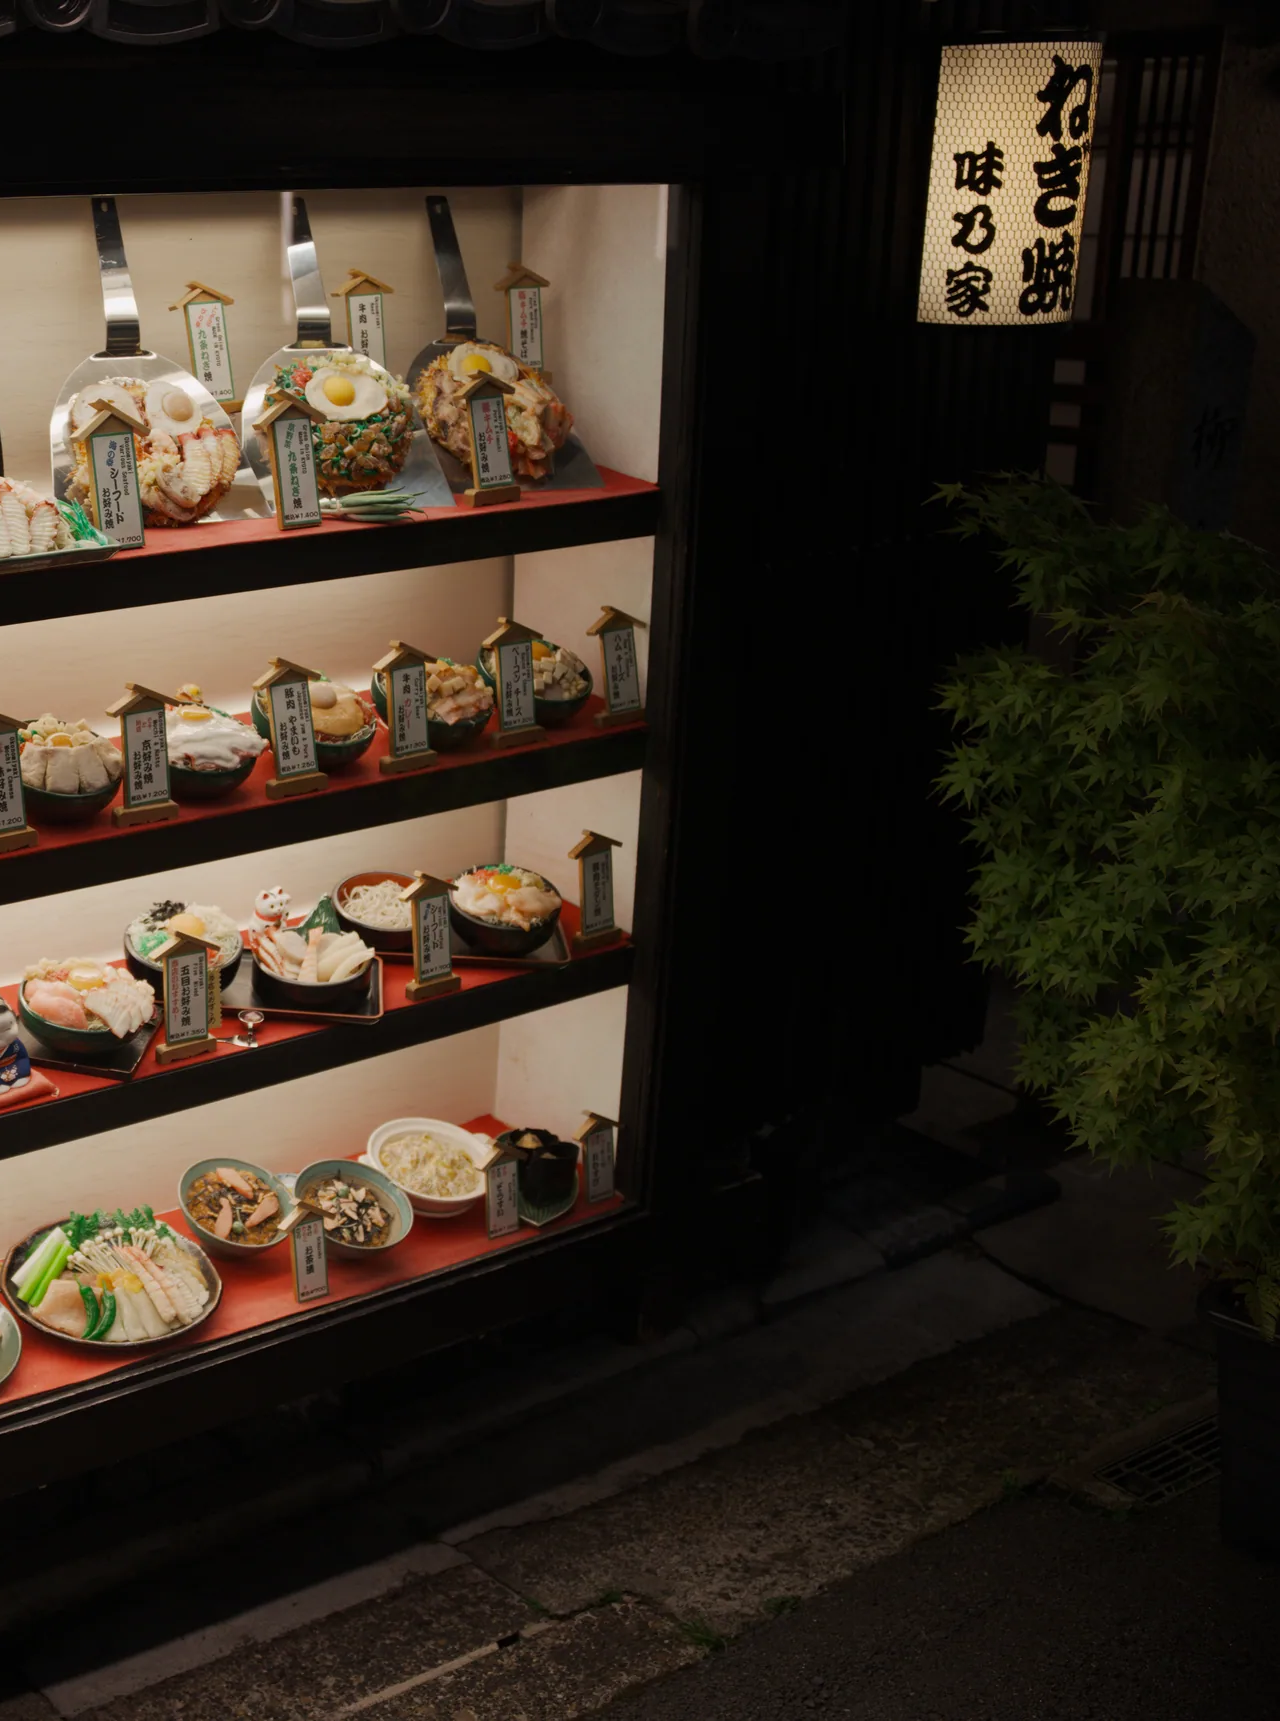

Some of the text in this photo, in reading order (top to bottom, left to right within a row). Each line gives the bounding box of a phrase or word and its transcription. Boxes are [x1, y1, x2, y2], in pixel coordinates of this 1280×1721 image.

[1019, 54, 1093, 316] ねぎ焼
[944, 141, 1005, 317] 味乃家
[482, 402, 494, 445] 豚キムチ
[119, 444, 130, 496] Various Seafood
[124, 437, 133, 474] Okonomiyaki
[479, 432, 490, 473] お好み焼
[103, 488, 114, 530] お好み焼
[110, 467, 124, 524] シーフード
[284, 687, 300, 756] 豚肉 やまいも
[404, 698, 413, 729] カレー
[9, 736, 19, 779] Okonomiyaki
[280, 722, 290, 761] お好み焼
[133, 751, 143, 791] お好み焼
[431, 904, 440, 950] シーフード
[180, 965, 191, 1027] 五目お好み焼
